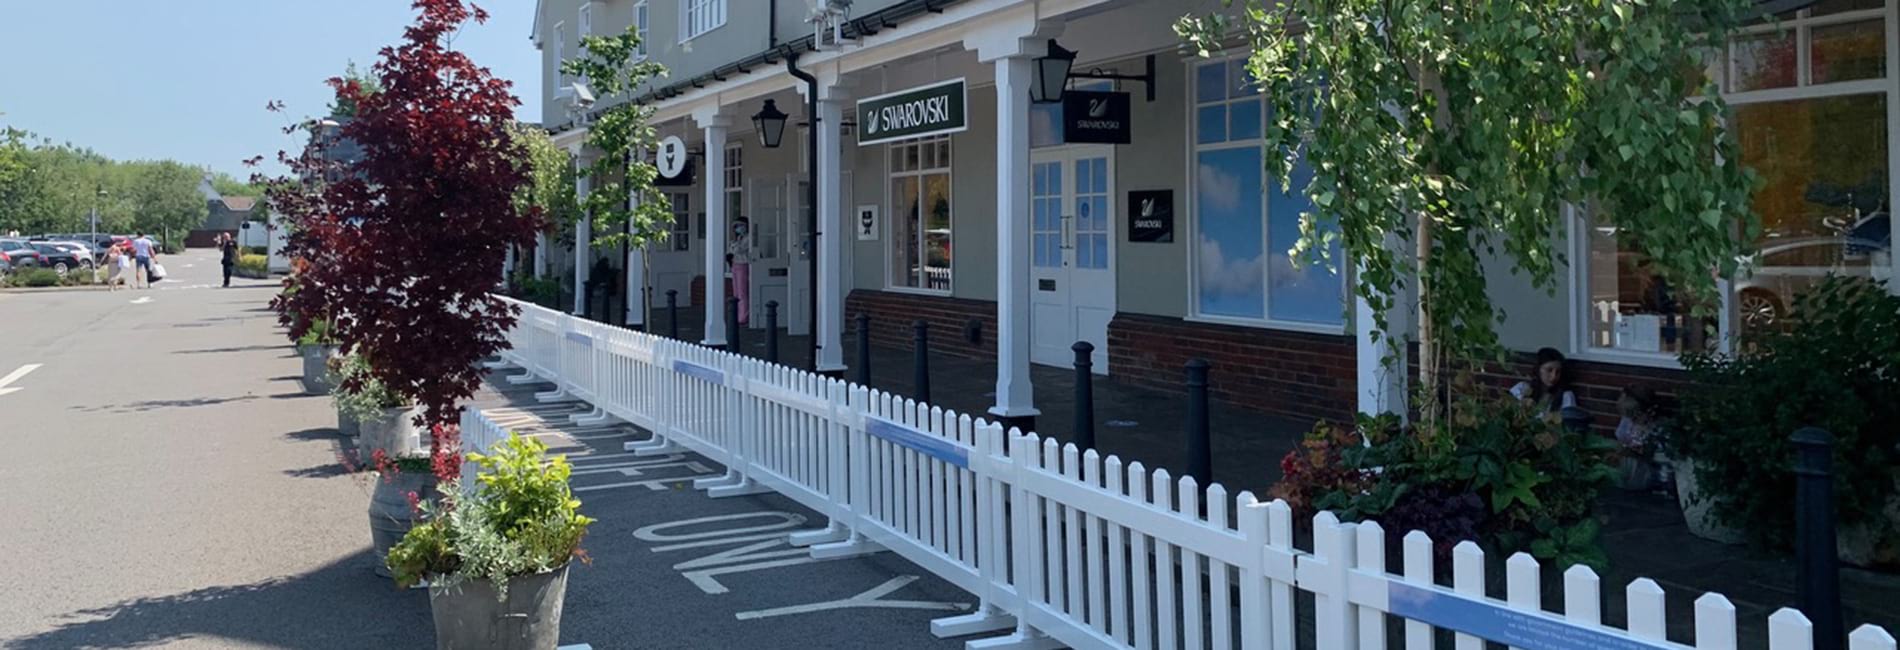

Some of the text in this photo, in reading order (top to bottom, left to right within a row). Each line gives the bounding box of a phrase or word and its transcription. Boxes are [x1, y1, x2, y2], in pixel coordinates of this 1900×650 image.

[881, 95, 949, 131] SWAROVSKI
[1077, 120, 1120, 129] SWAROVSKI
[1134, 219, 1162, 229] SWAROVSKI
[632, 511, 972, 620] ONLY
